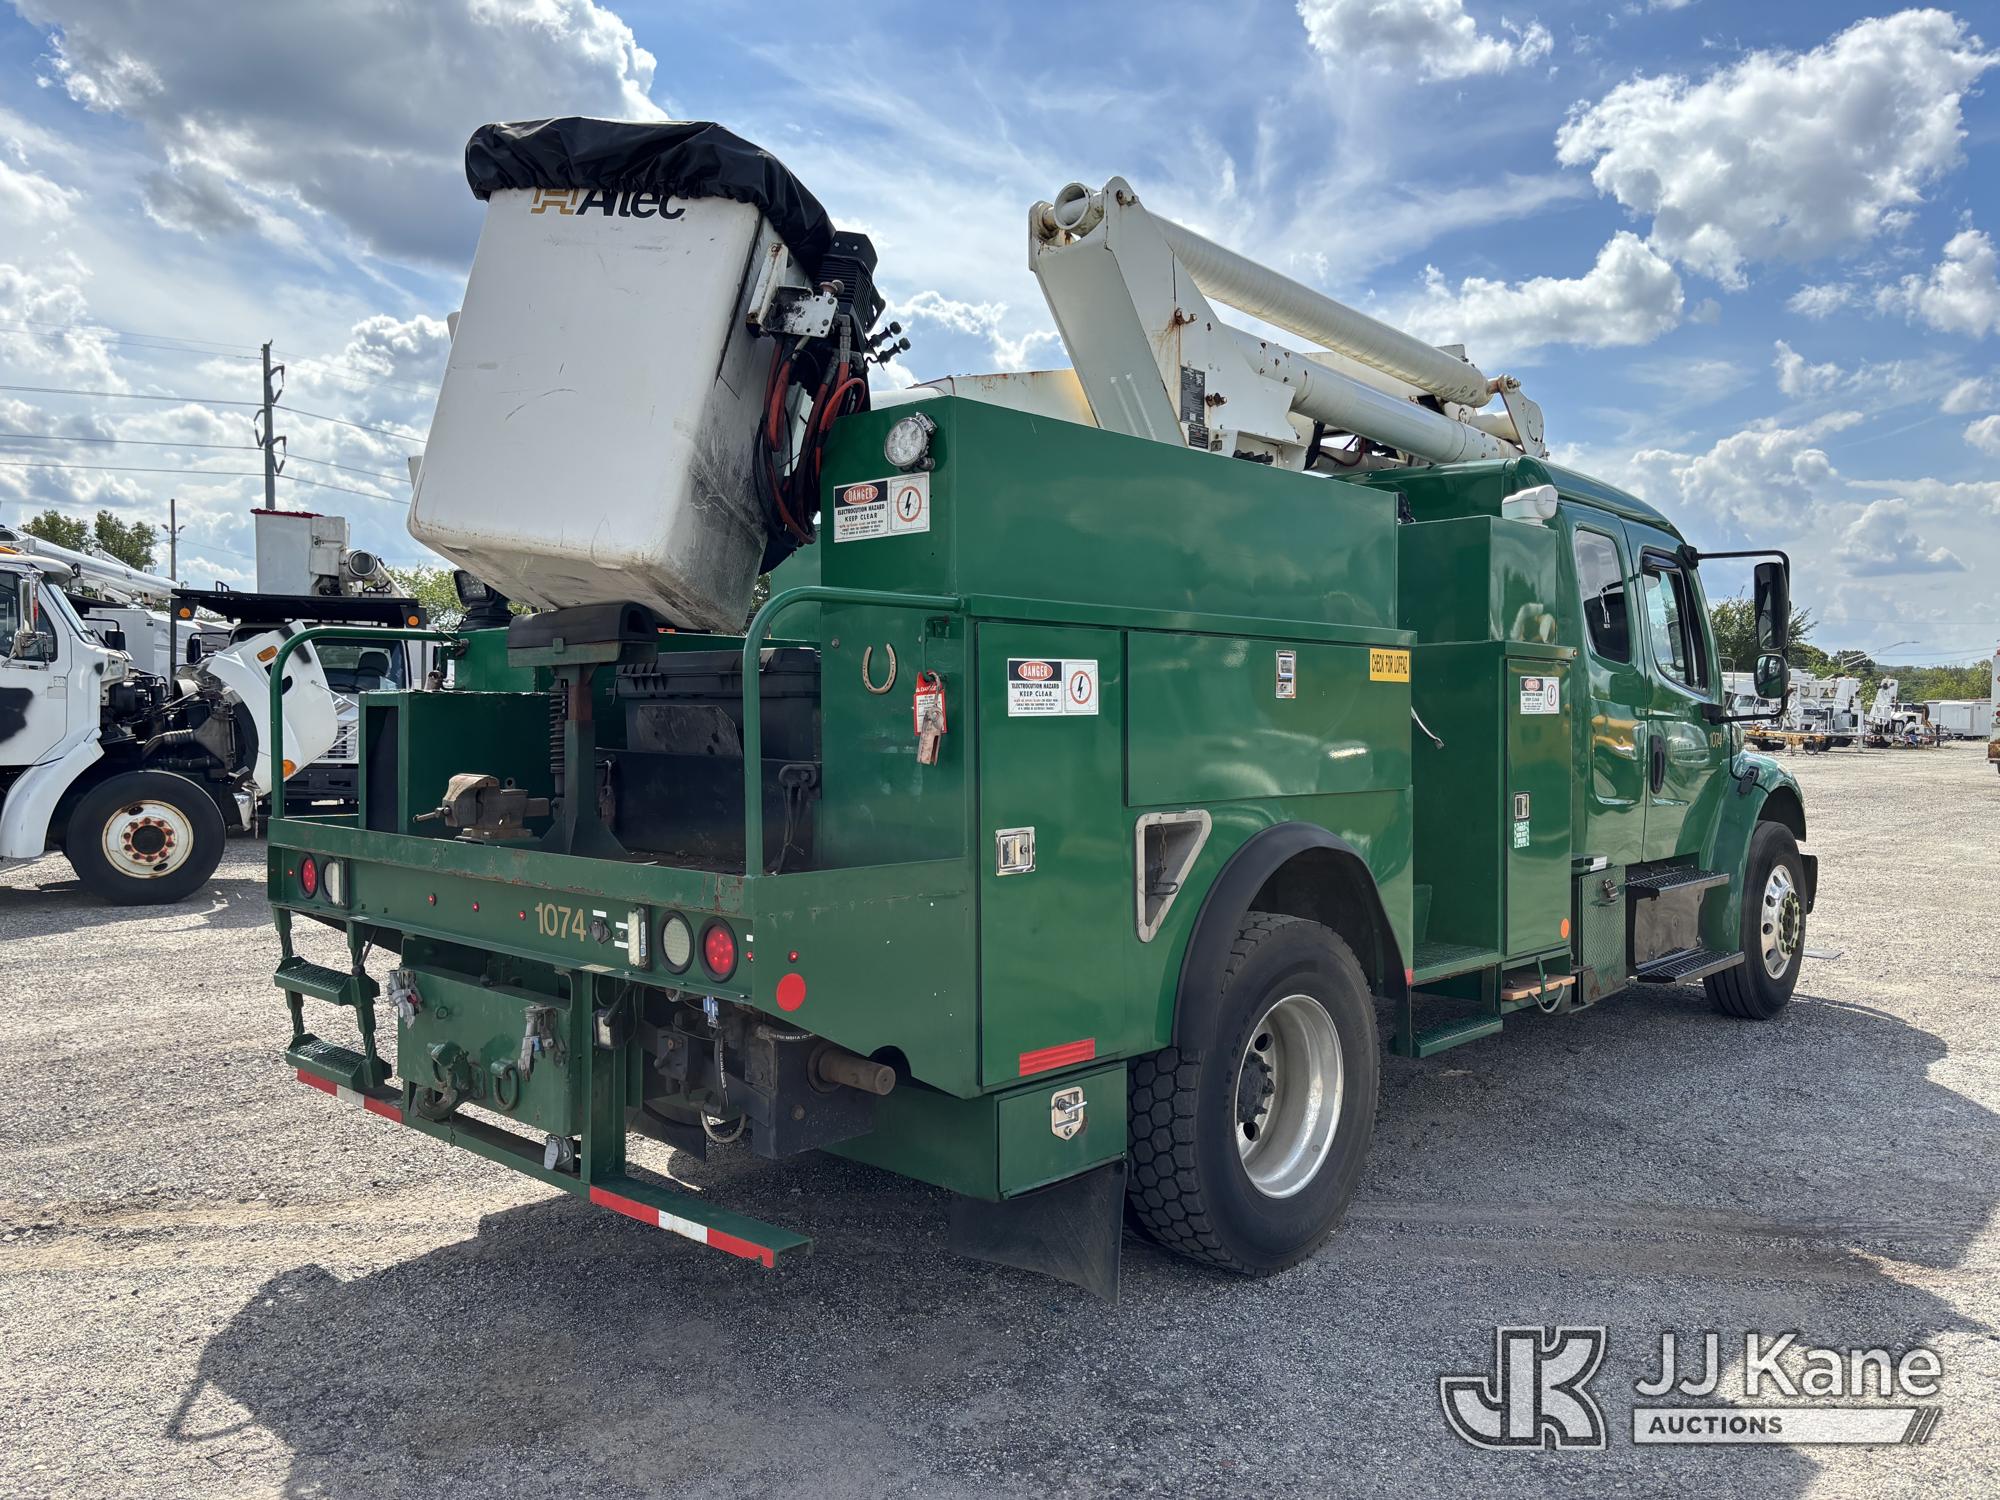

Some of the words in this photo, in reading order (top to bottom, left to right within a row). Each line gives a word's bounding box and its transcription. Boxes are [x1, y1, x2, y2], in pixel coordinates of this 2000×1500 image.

[576, 188, 686, 220] Altec
[848, 487, 873, 502] DANGER
[868, 503, 886, 511] HAZARD
[860, 513, 878, 521] CLEAR
[1023, 665, 1048, 677] DANGER
[1371, 653, 1384, 673] CHECK
[1385, 654, 1393, 674] FOR
[534, 902, 587, 942] 1074
